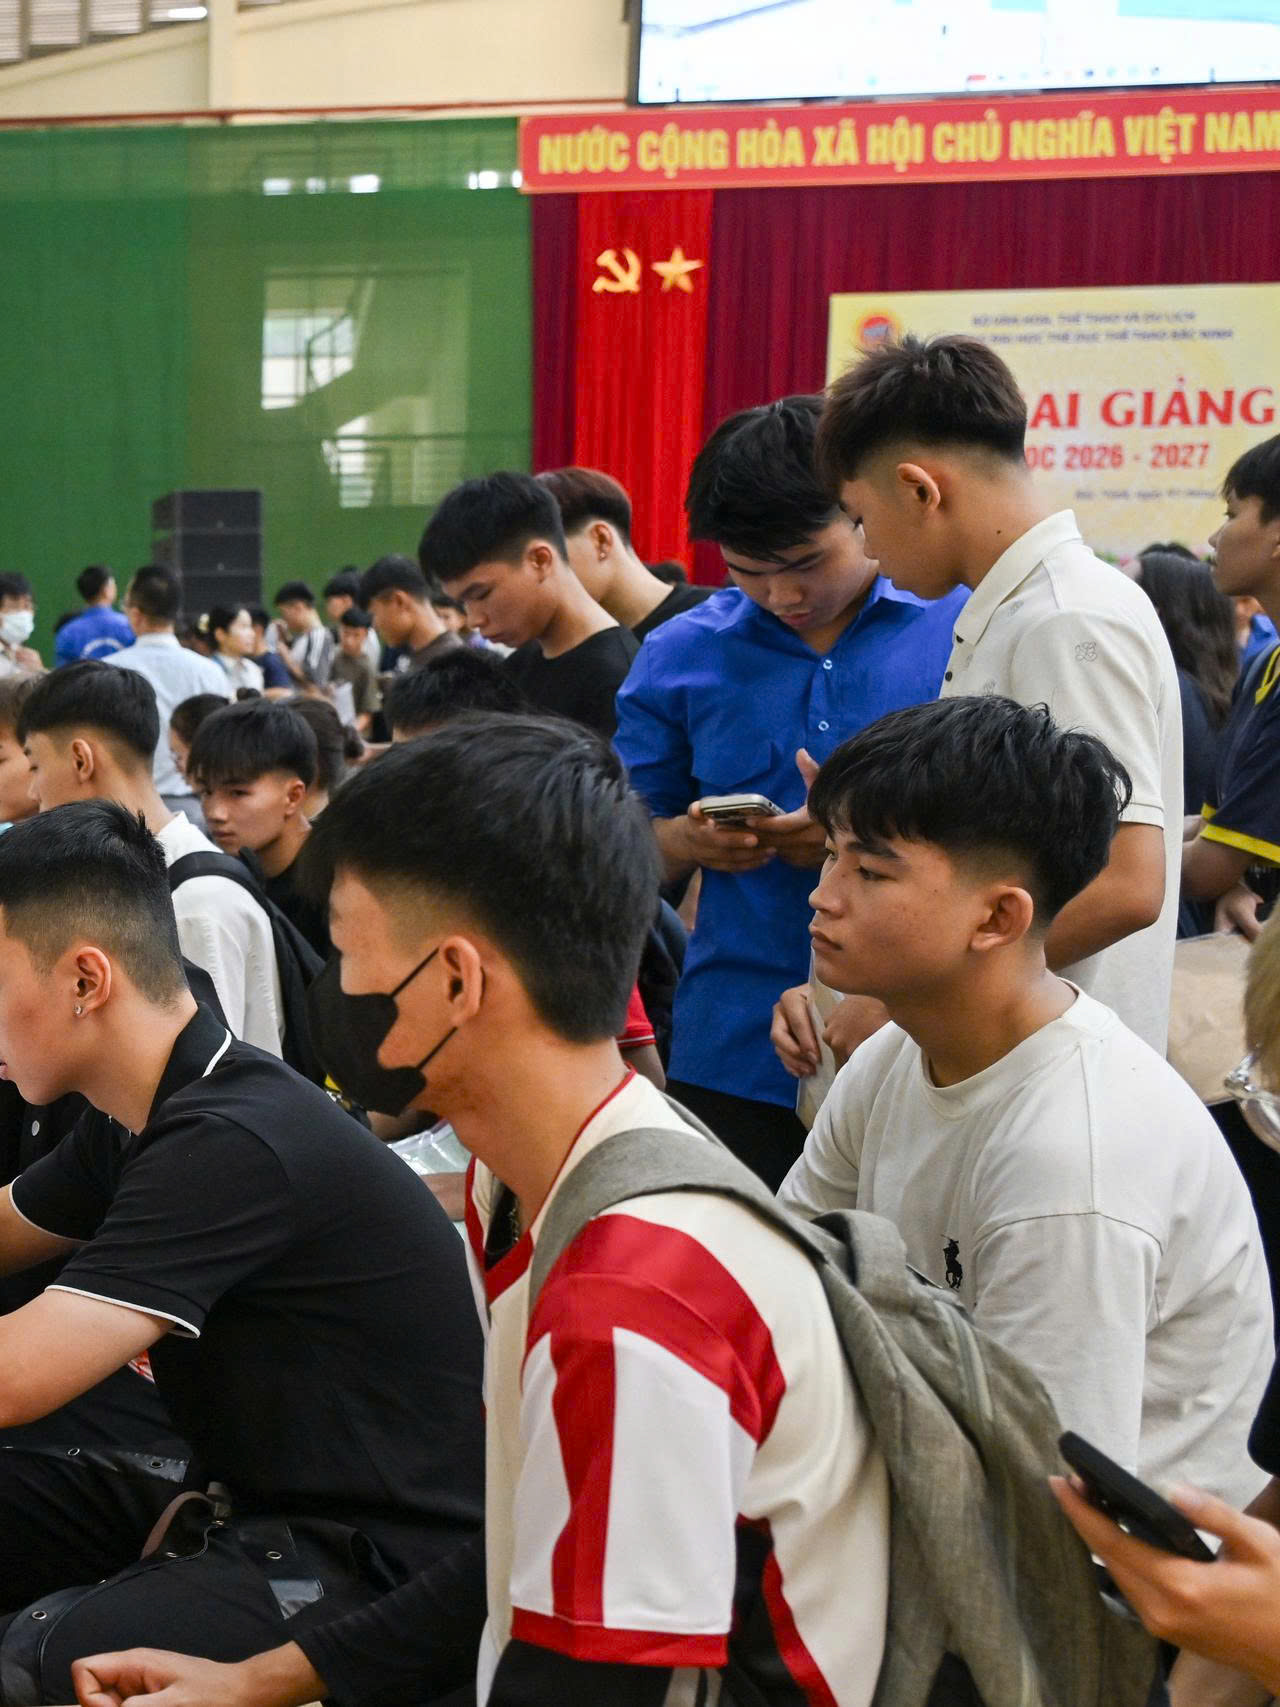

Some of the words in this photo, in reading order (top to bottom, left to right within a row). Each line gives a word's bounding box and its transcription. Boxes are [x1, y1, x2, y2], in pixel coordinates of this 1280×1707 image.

[539, 124, 631, 174] NƯỚC
[637, 122, 730, 179] CỘNG
[811, 118, 860, 167] XÃ
[867, 116, 925, 173] HỘI
[932, 108, 1003, 164] CHỦ
[1009, 110, 1116, 160] NGHĨA
[1123, 106, 1198, 163] VIỆT
[1204, 110, 1280, 154] NAM
[1028, 391, 1080, 429] AI
[1101, 377, 1275, 428] GIẢNG
[1150, 442, 1210, 470] 2027
